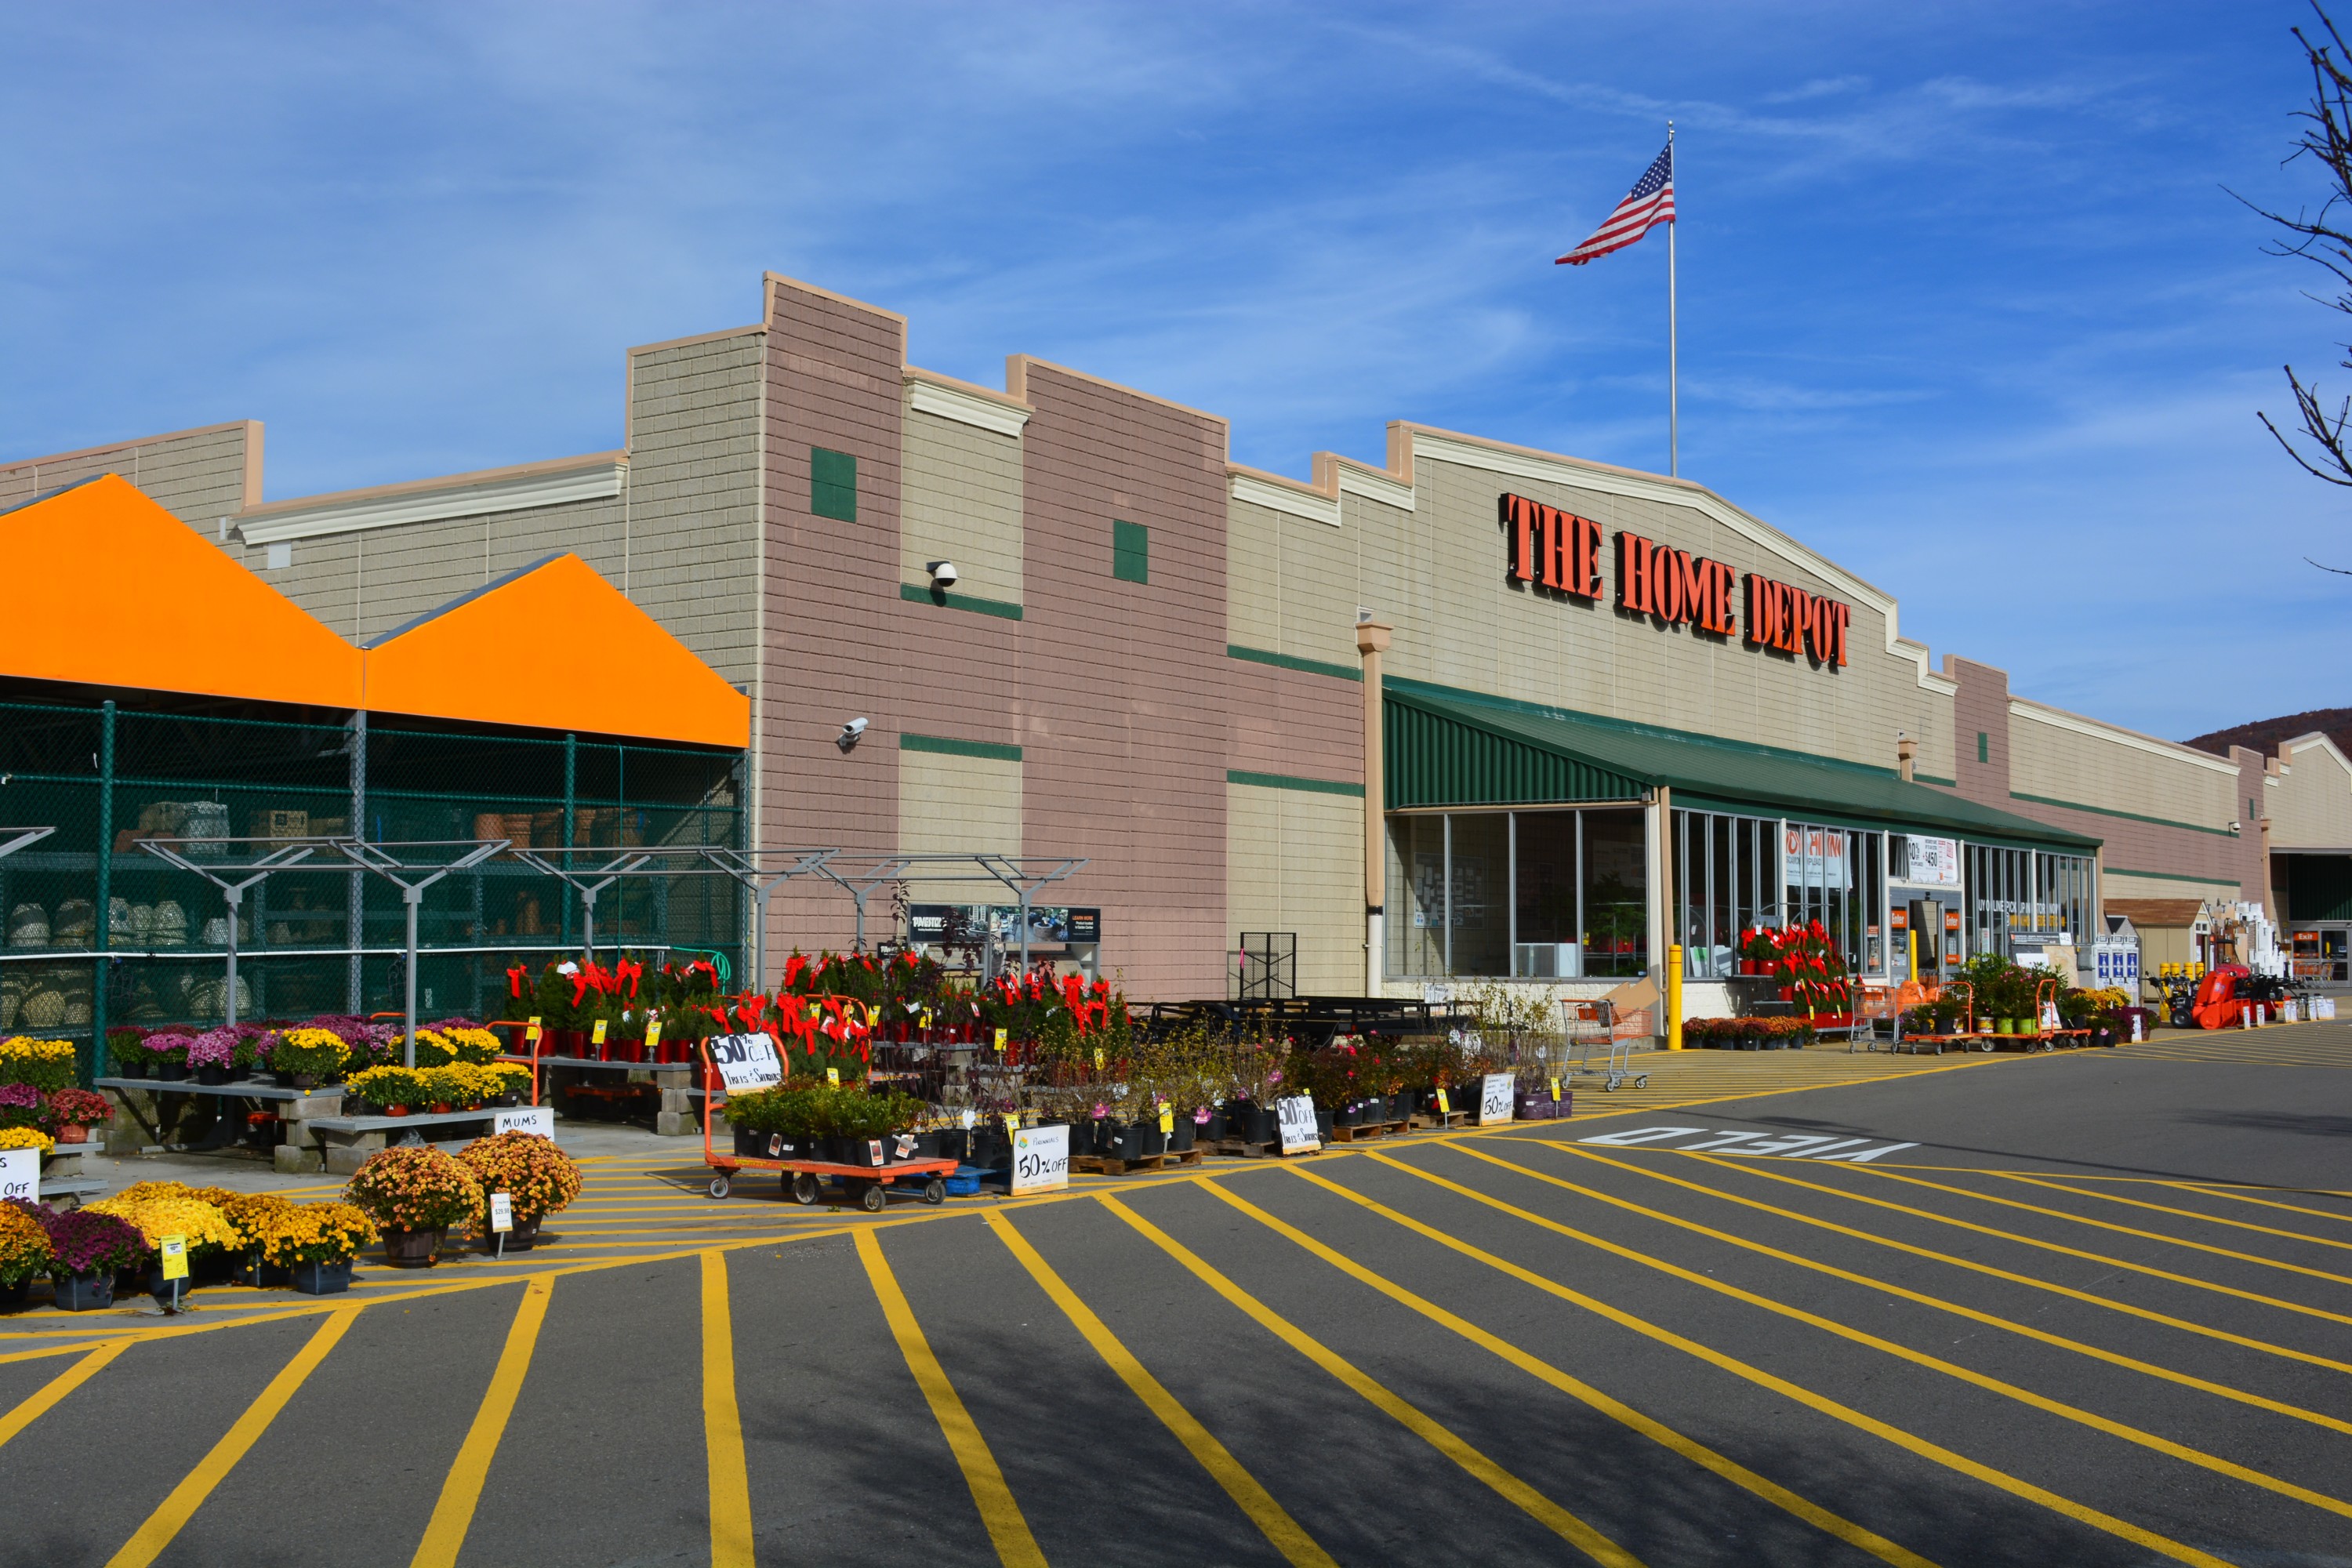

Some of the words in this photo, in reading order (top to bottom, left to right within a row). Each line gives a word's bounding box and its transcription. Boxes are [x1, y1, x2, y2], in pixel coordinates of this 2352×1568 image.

[1501, 492, 1603, 601] THE
[1613, 531, 1736, 637] HOME
[1744, 572, 1851, 667] DEPOT
[1891, 911, 1905, 925] Enter
[1946, 914, 1958, 927] Enter
[1277, 1098, 1302, 1125] 50%
[1298, 1109, 1313, 1124] OFF
[1484, 1095, 1504, 1116] 50%
[1503, 1100, 1513, 1112] OFF
[502, 1114, 537, 1128] MUMS
[1577, 1127, 1923, 1163] YIELD
[1018, 1153, 1051, 1179] 50%
[1051, 1156, 1069, 1173] OFF
[4, 1181, 30, 1196] OFF
